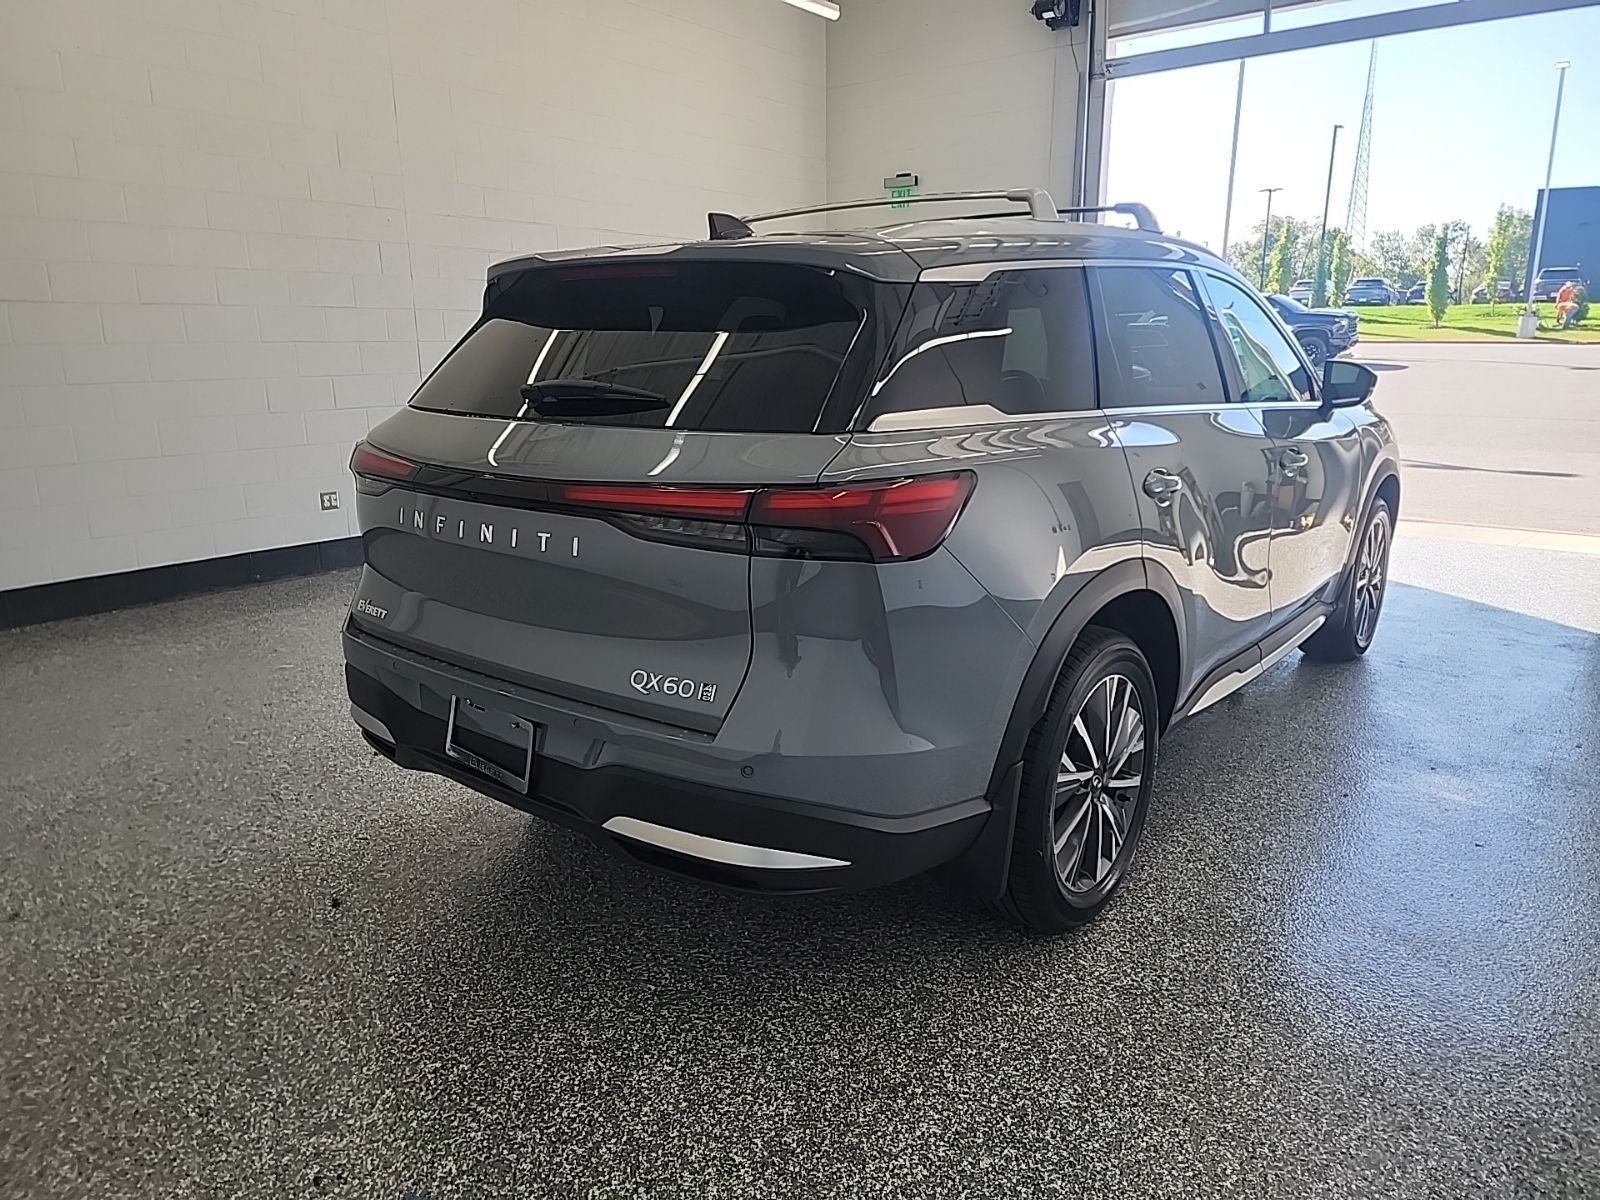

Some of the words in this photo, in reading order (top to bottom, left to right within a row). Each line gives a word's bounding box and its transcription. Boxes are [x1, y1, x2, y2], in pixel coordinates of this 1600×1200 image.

[891, 189, 912, 209] EXIT
[400, 506, 579, 557] INFINITI
[358, 599, 388, 619] EVERETT
[630, 669, 695, 698] QX60
